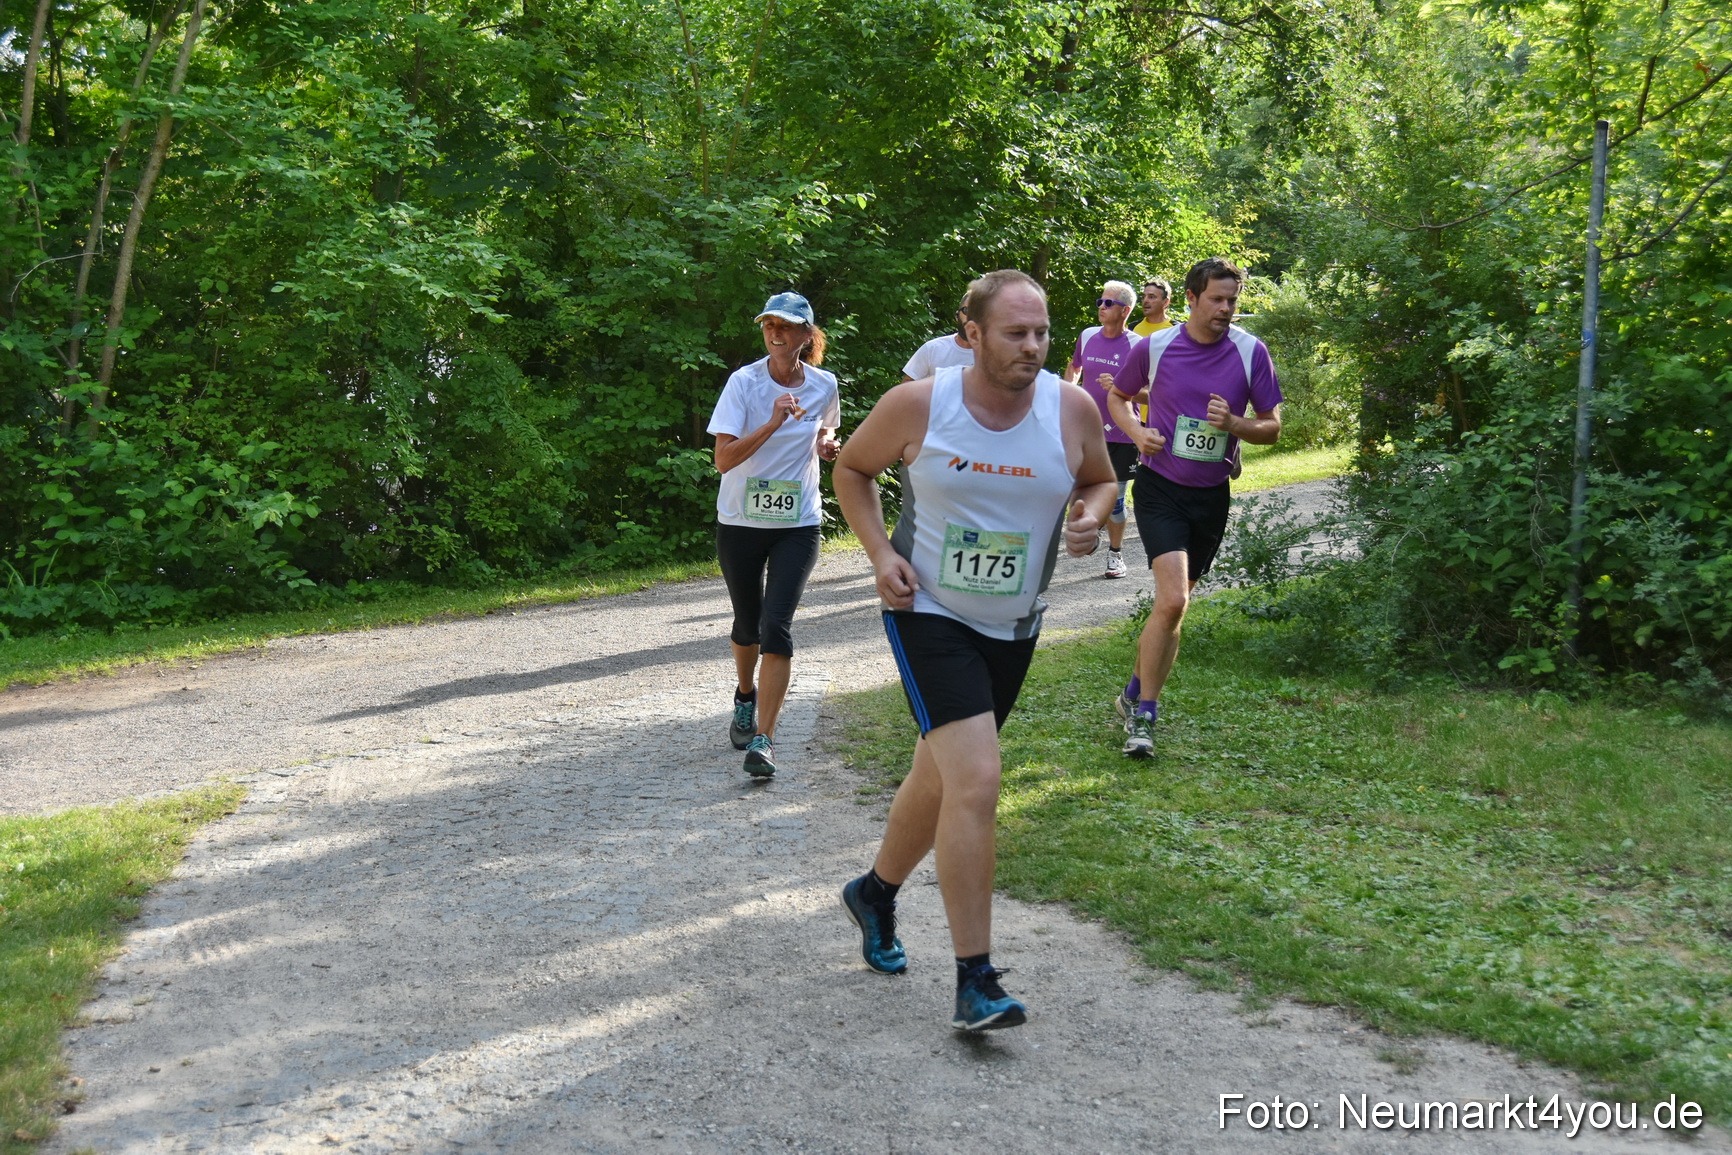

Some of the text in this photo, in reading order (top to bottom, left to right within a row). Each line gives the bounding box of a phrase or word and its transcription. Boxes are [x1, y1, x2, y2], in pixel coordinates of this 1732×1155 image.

[1185, 433, 1216, 450] 630
[972, 462, 1037, 478] KLEBL
[753, 493, 794, 510] 1349
[953, 550, 1016, 579] 1175
[963, 576, 979, 584] Nutz
